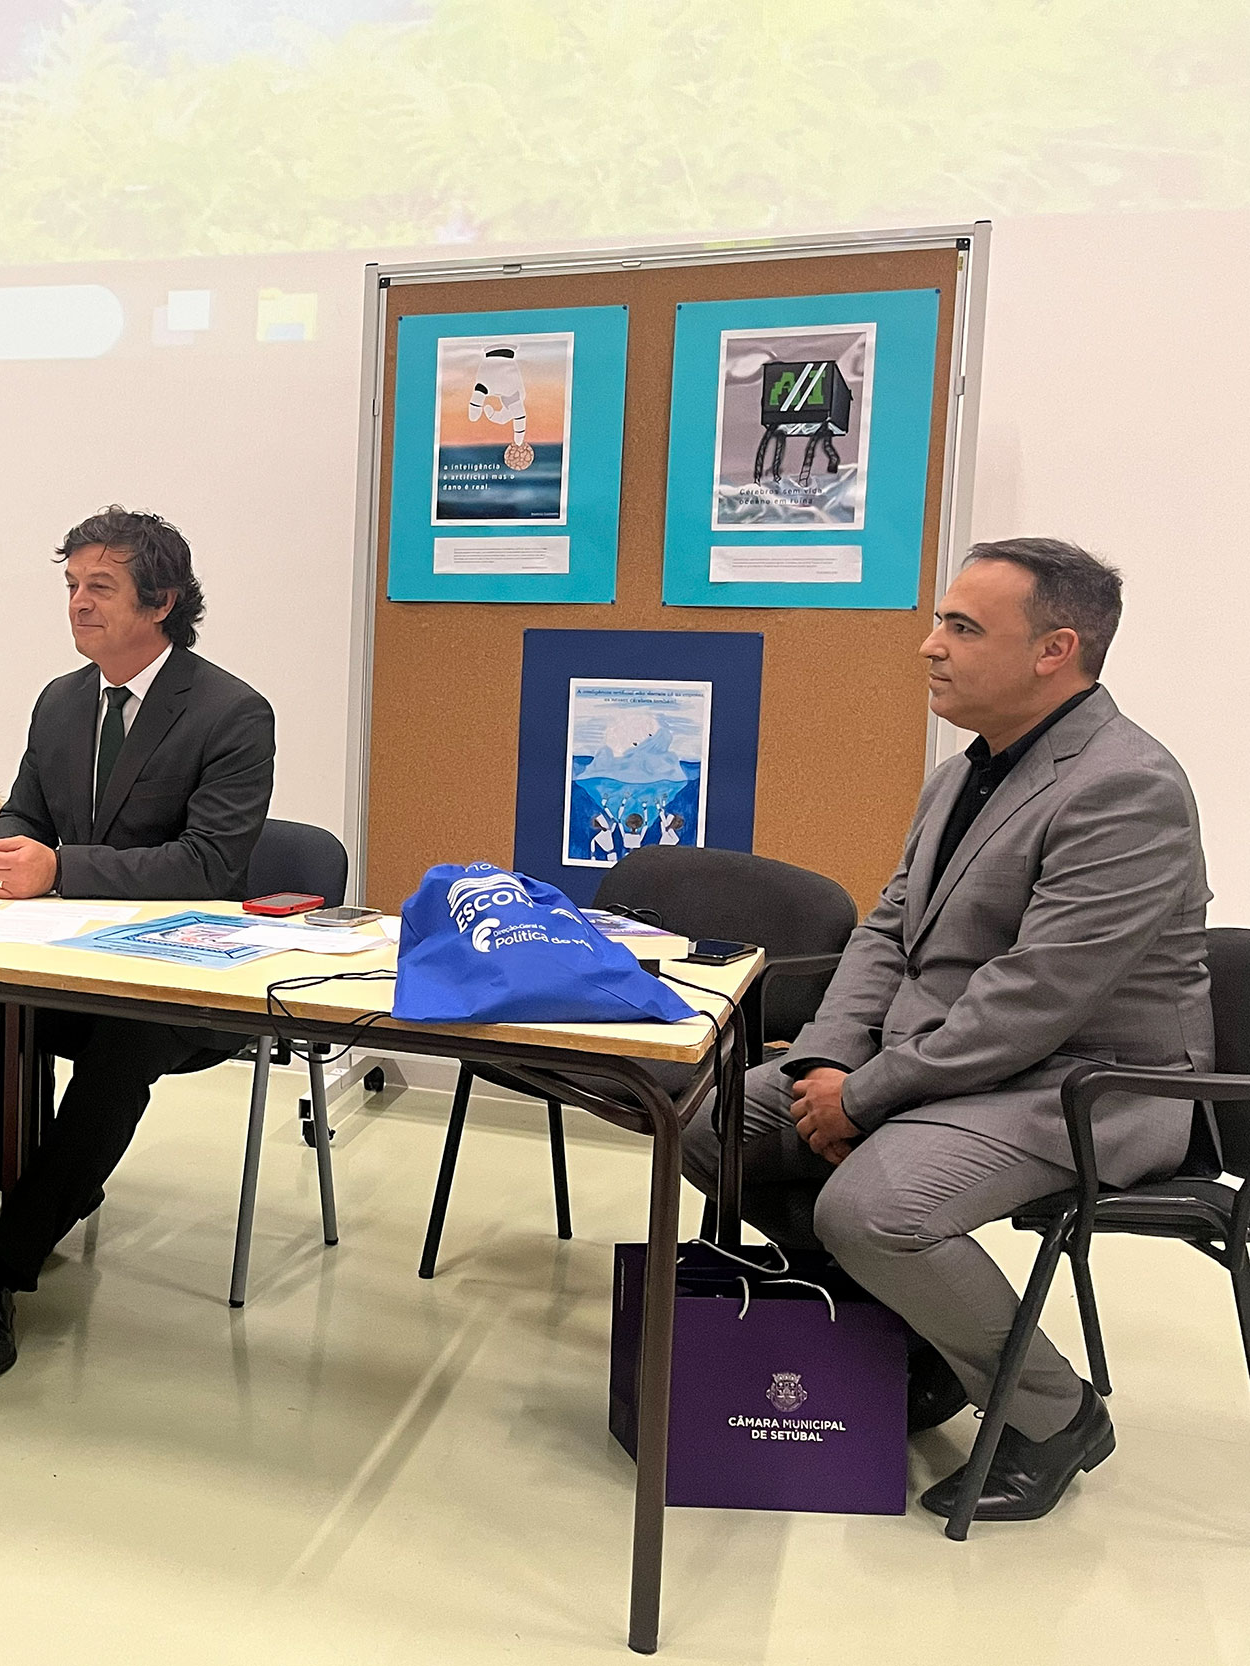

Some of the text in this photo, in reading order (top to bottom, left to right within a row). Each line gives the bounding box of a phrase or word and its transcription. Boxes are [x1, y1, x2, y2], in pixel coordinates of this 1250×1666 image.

[451, 463, 500, 472] inteligência
[495, 929, 550, 949] Política
[728, 1414, 846, 1431] CÂMARA MUNICIPAL
[751, 1429, 824, 1442] DE SETÚBAL
